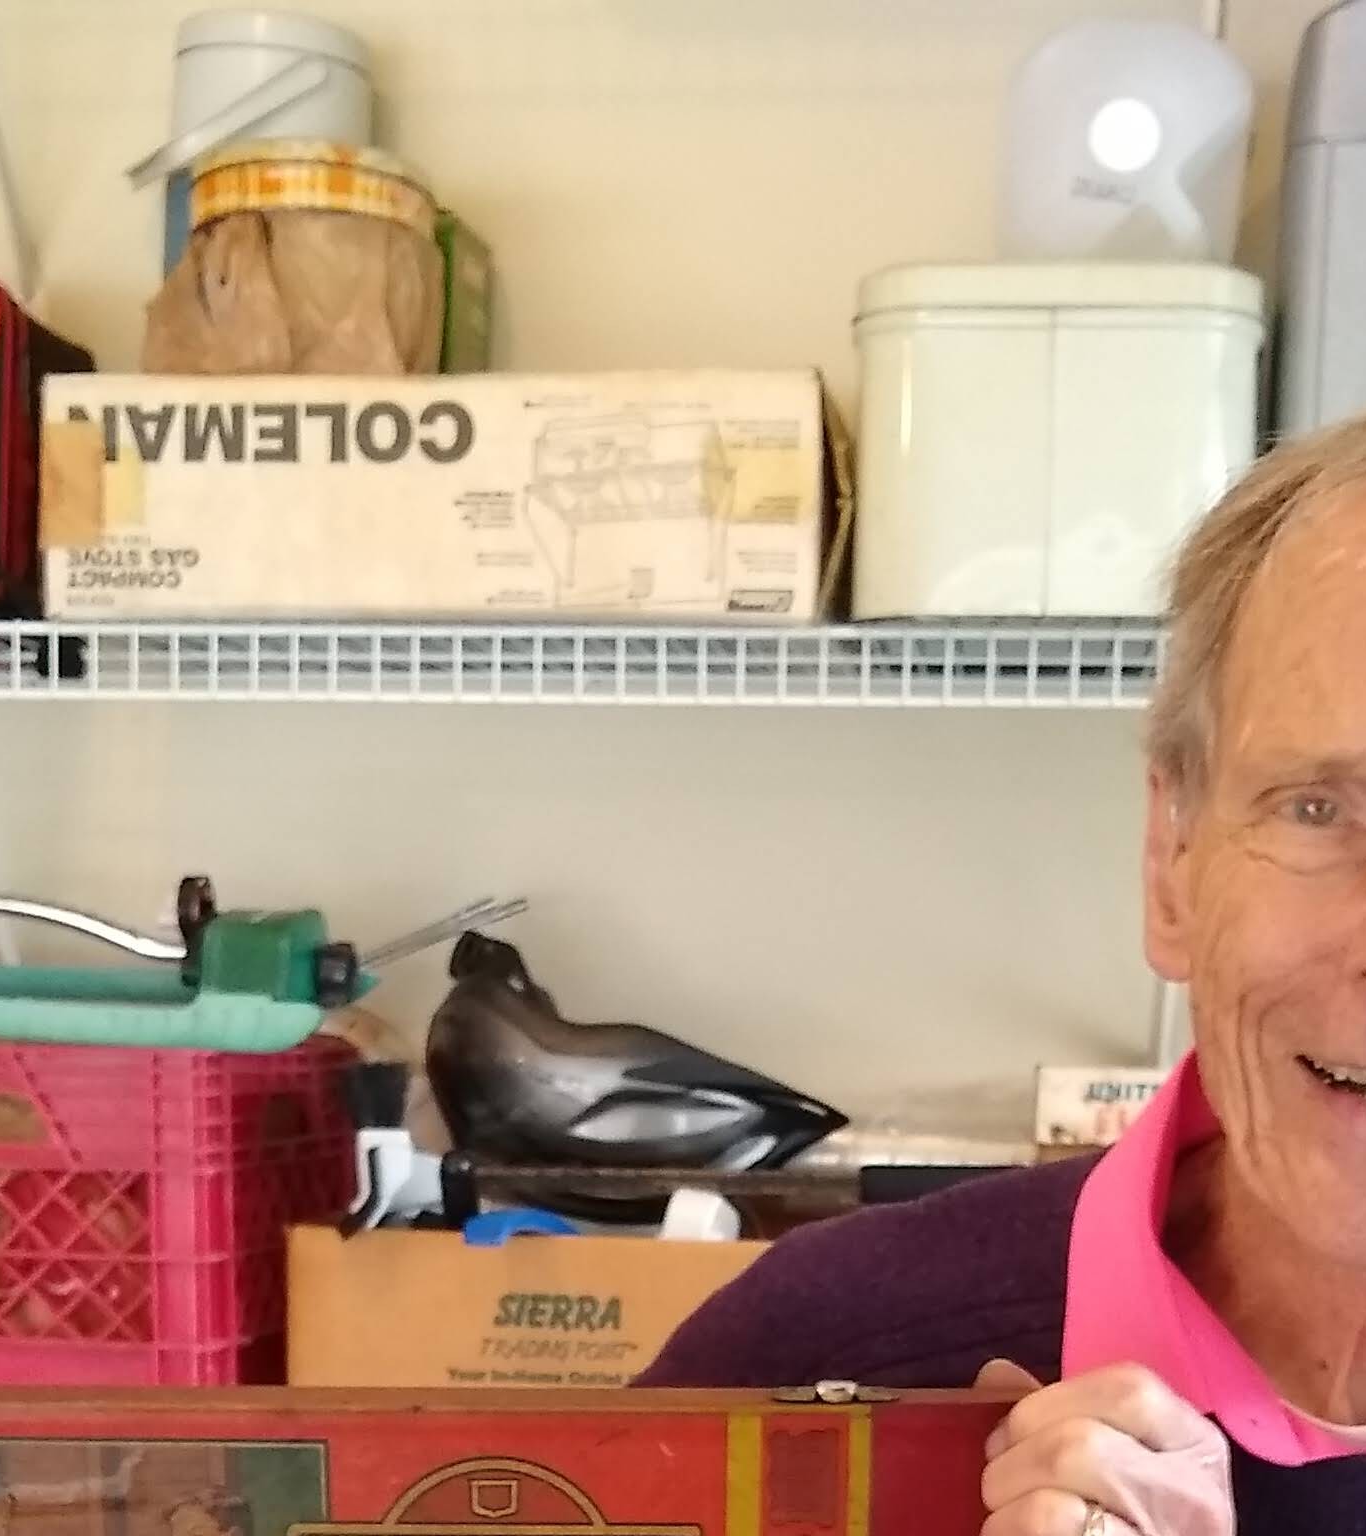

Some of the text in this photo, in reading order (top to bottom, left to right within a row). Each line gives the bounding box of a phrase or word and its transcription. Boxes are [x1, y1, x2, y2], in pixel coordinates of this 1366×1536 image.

[67, 548, 200, 568] GAS STOVE
[67, 570, 181, 589] COMPACT
[493, 1292, 622, 1331] SIERRA
[480, 1339, 571, 1361] TRADING
[447, 1367, 486, 1383] Your
